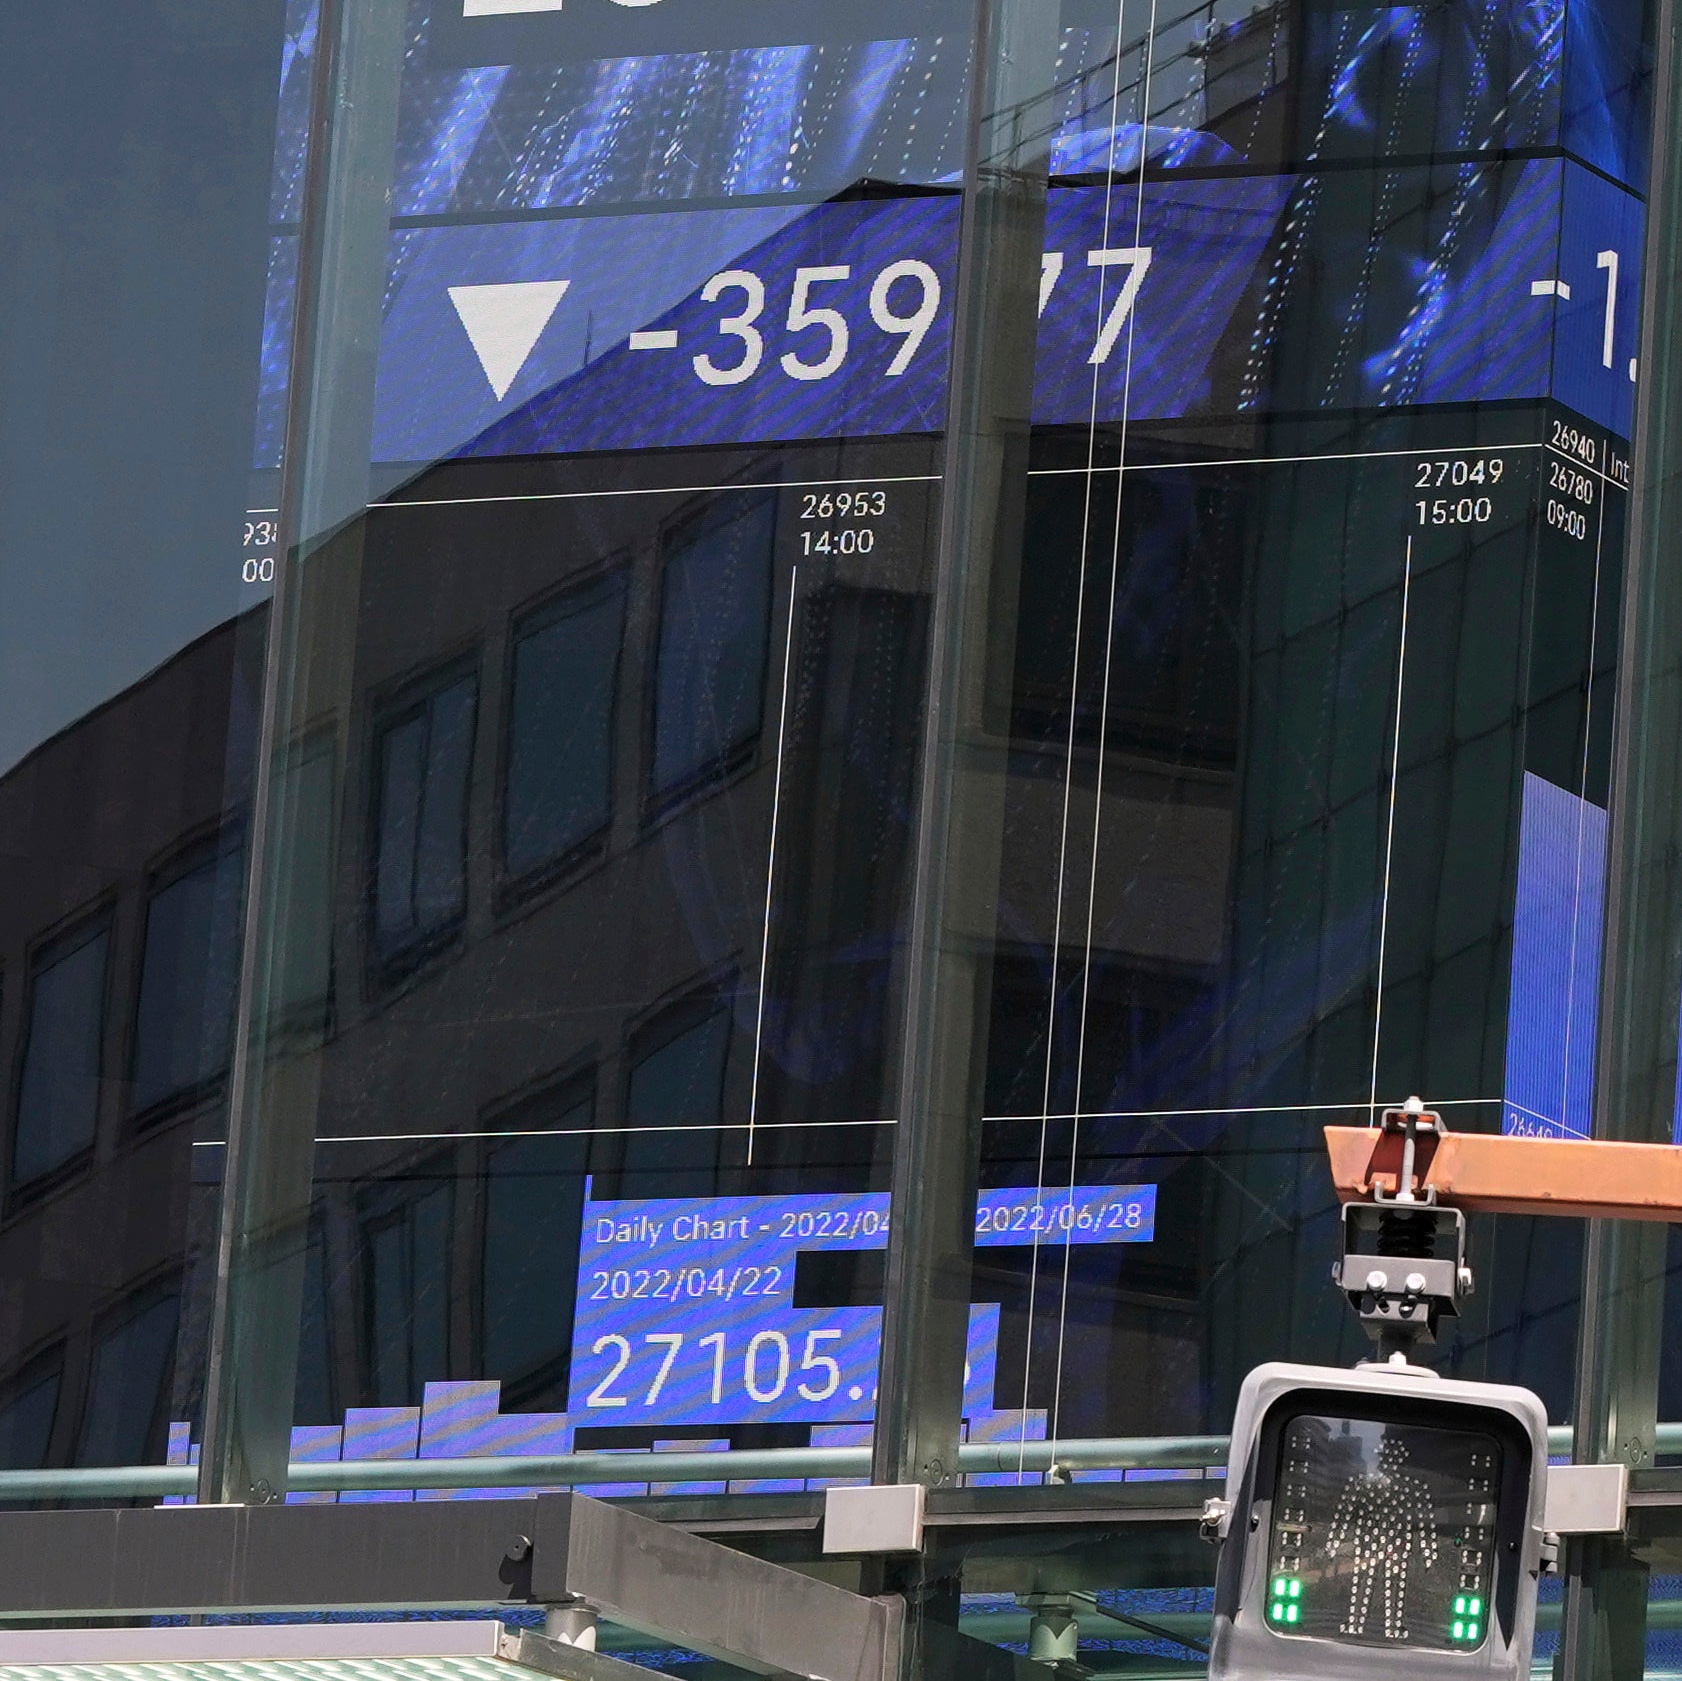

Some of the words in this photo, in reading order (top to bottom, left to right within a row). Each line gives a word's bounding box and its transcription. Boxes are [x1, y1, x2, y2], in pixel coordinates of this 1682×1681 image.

[628, 246, 1153, 387] -3597
[1551, 419, 1596, 464] 26940
[1414, 458, 1504, 488] 27049
[1549, 461, 1594, 505] 26780
[800, 491, 886, 519] 26953
[1415, 497, 1492, 525] 15:00
[1547, 499, 1586, 540] 09:00
[800, 529, 875, 556] 14:00
[596, 1214, 664, 1249] Daily
[672, 1214, 750, 1242] Chart
[975, 1202, 1143, 1234] 2022/06/28
[589, 1265, 783, 1303] 2022/04/22
[586, 1328, 971, 1408] 27105.
